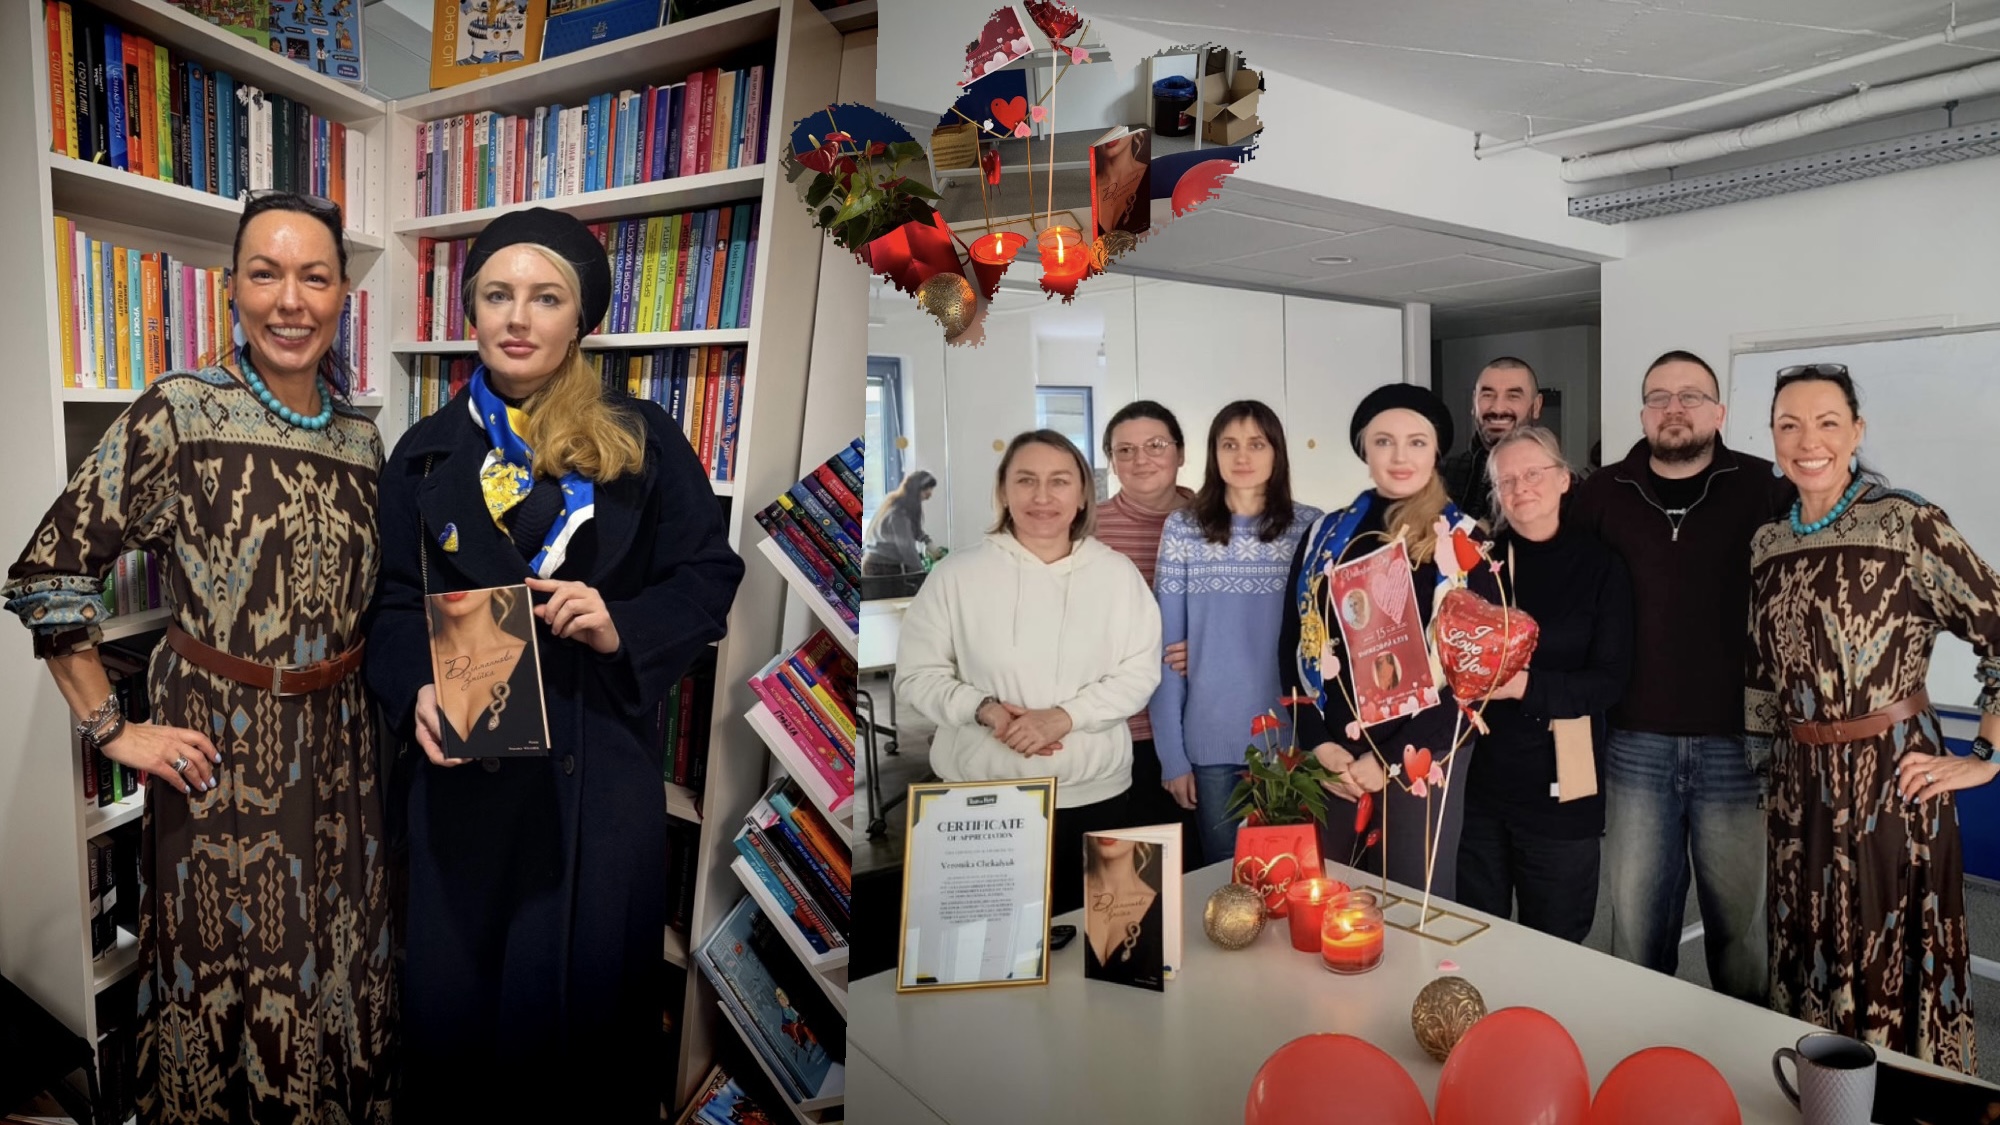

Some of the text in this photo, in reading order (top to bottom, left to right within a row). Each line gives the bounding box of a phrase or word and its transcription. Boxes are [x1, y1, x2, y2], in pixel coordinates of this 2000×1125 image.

[443, 5, 456, 67] ЩО ВОНО
[78, 61, 89, 116] СТОРІТЕЛІНГ
[113, 106, 122, 138] СПАРТИ
[625, 224, 635, 270] ПИХАТОСТІ
[635, 223, 646, 271] ЗАБОБОНИ
[661, 226, 670, 258] ВІРИТИ
[614, 250, 624, 294] ЗАЗДРІСТЬ
[643, 264, 653, 298] БРЕХНЯ
[660, 259, 667, 275] ЩО
[622, 271, 631, 303] ІСТОРІЯ
[133, 307, 141, 336] УРОКИ
[726, 402, 734, 422] ВОНА
[1376, 627, 1387, 640] 15
[1448, 627, 1484, 655] Love
[1466, 625, 1493, 641] I
[1453, 651, 1491, 676] You
[937, 818, 1025, 833] CERTIFICATE
[960, 832, 1013, 841] APPRECIATION
[941, 860, 975, 870] Veronika
